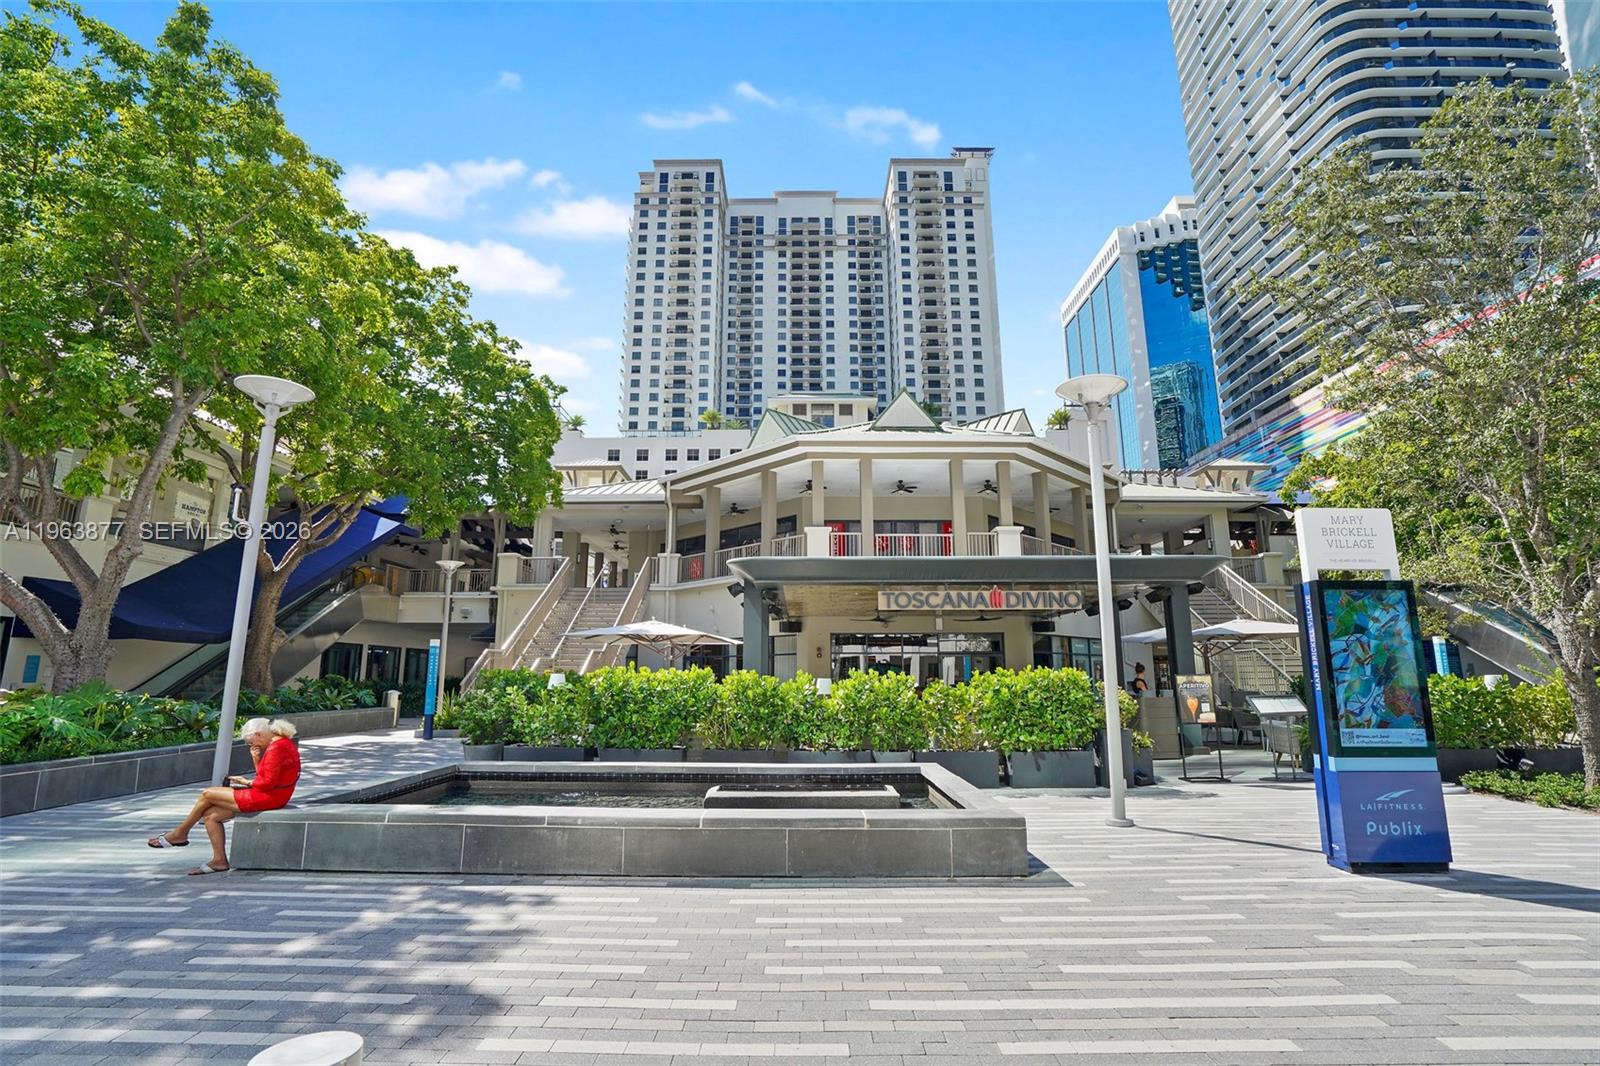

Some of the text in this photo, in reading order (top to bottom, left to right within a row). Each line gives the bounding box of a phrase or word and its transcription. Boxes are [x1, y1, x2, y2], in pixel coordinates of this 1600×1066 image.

[1330, 516, 1364, 525] MARY
[1321, 528, 1377, 537] BRICKELL
[1326, 539, 1375, 549] VILLAGE
[882, 591, 1082, 609] TOSCANA DIVINO
[1305, 595, 1321, 691] MARY BRICKELL VILLAGE
[1366, 821, 1423, 836] Publix
